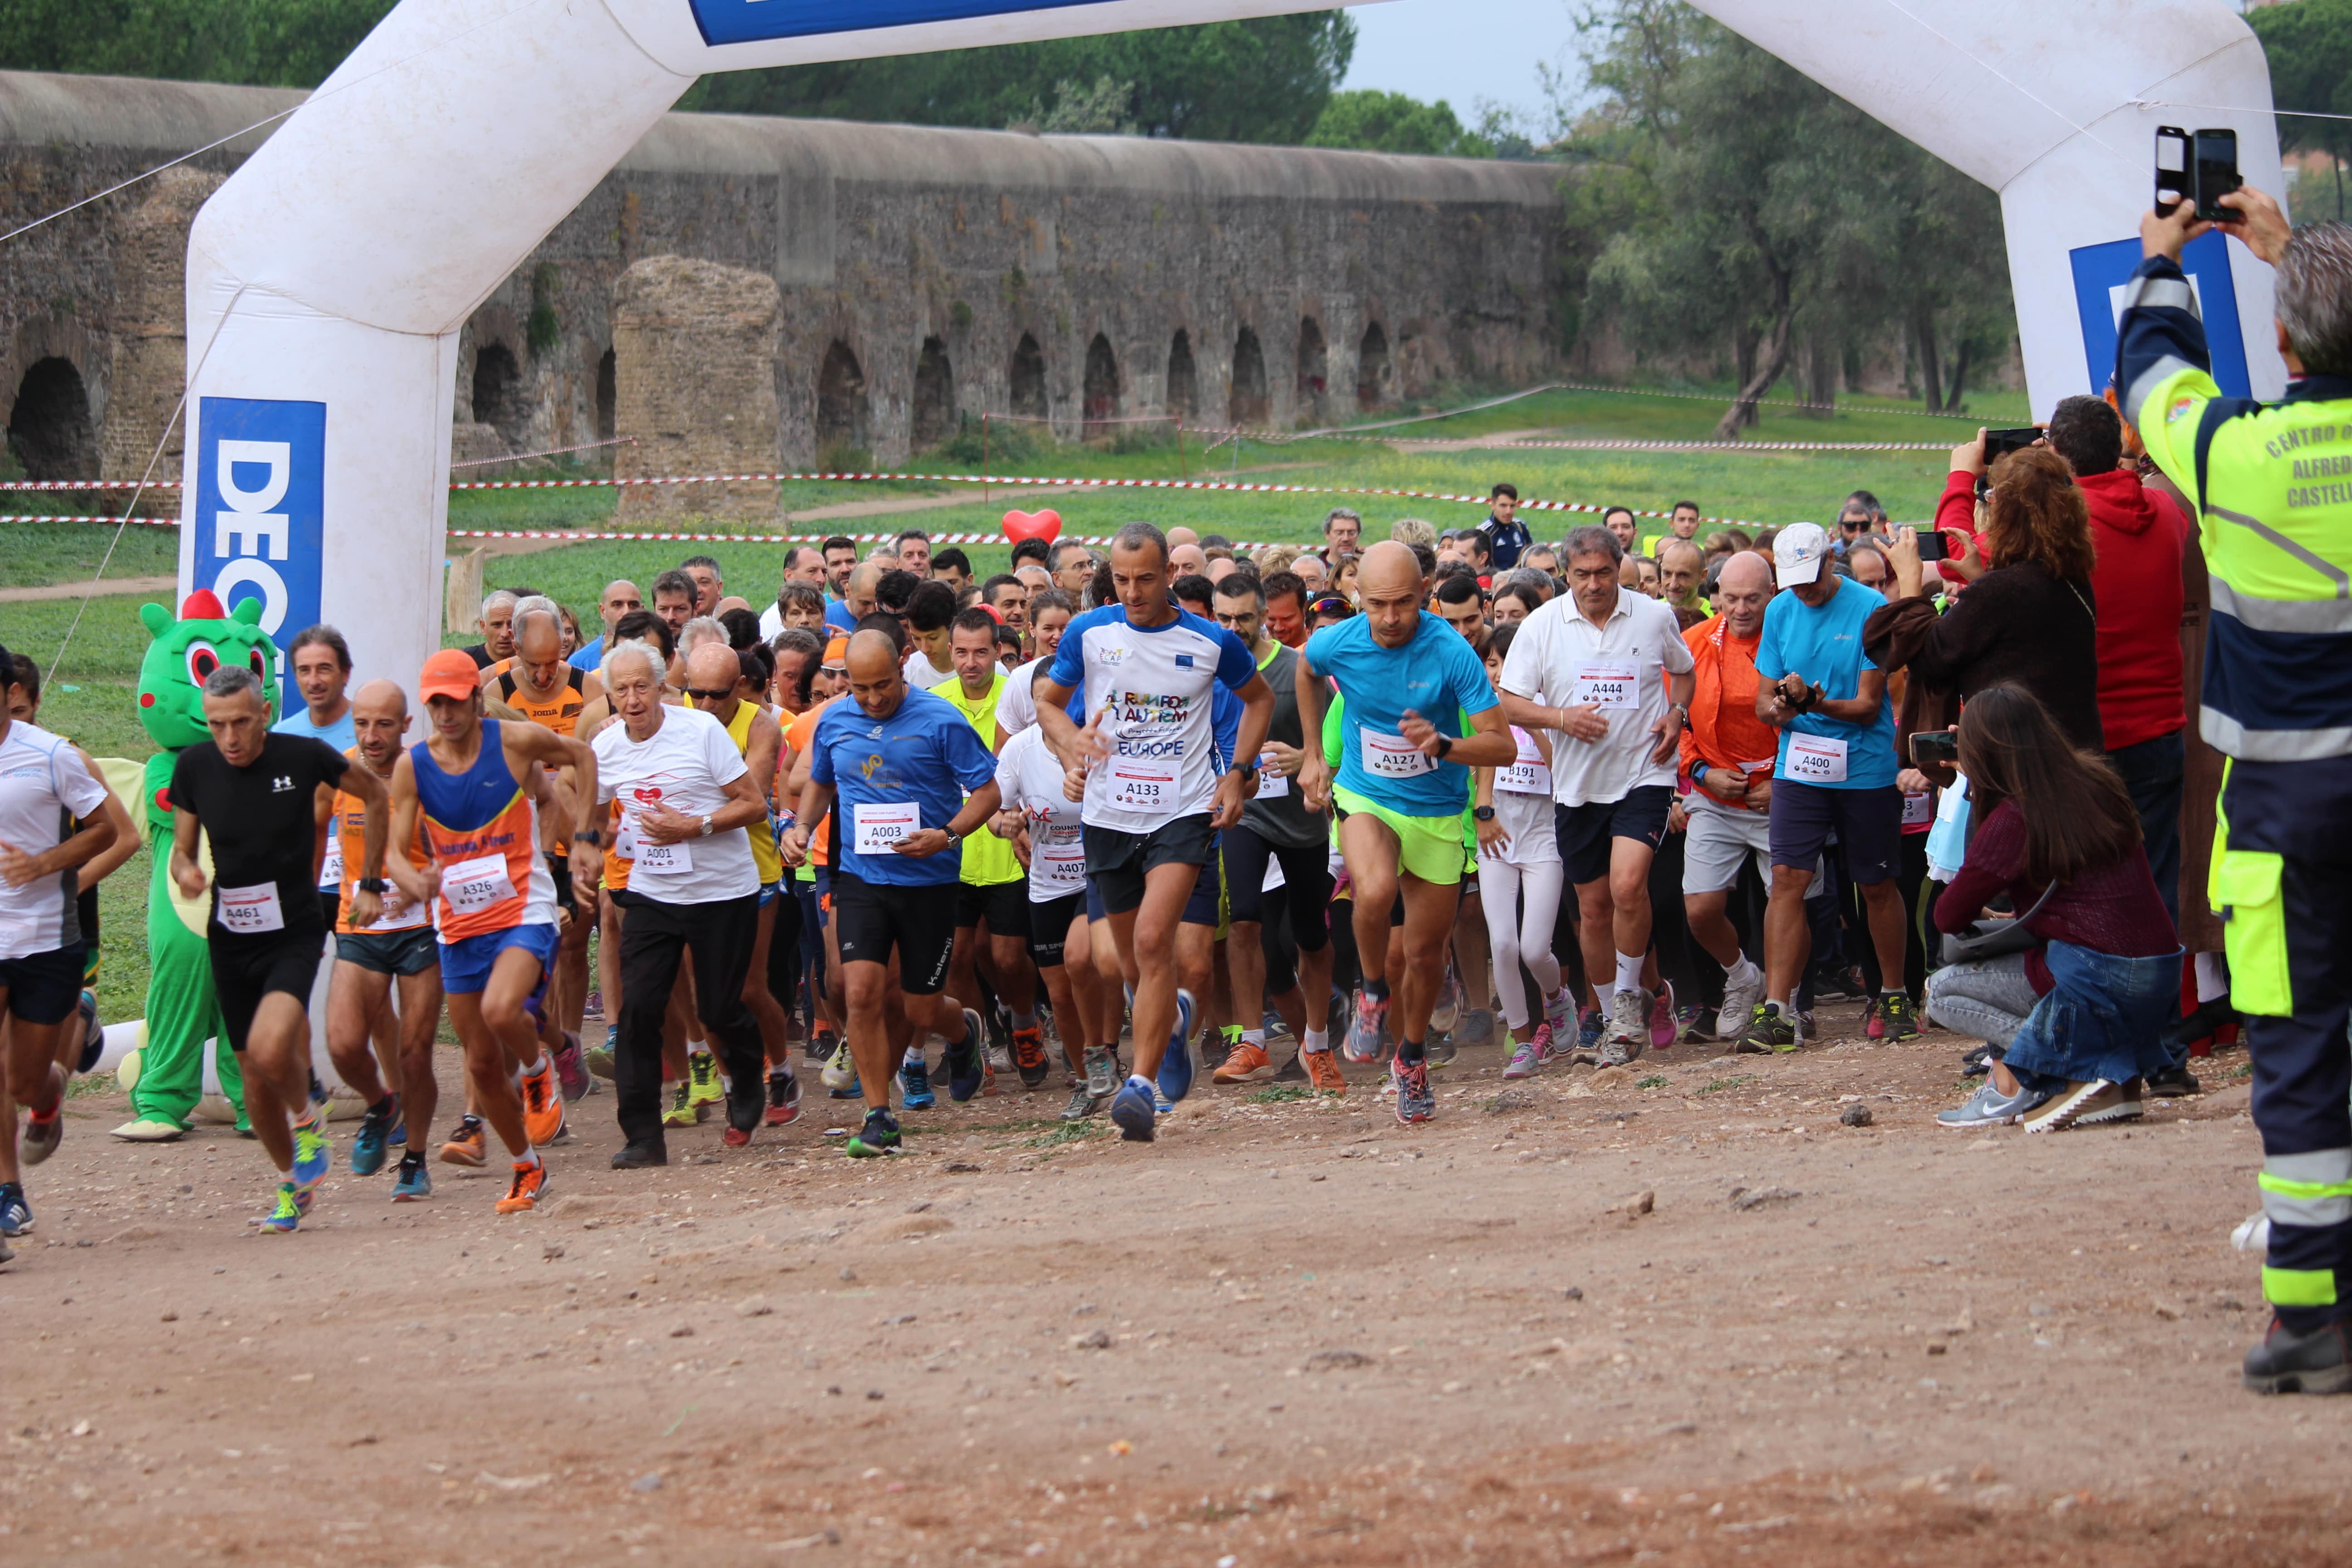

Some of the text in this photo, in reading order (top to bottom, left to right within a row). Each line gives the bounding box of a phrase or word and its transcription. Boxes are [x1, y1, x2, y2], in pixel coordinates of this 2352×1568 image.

[2266, 425, 2336, 460] CENTRO
[2293, 455, 2352, 480] ALFRED
[213, 439, 292, 637] DEC
[1100, 652, 1122, 662] ECAP
[1592, 684, 1622, 693] A444
[1125, 708, 1188, 723] AUTISM
[1118, 740, 1185, 755] EUROPE
[1383, 755, 1415, 764] A127
[1802, 756, 1829, 768] A400
[1509, 766, 1534, 777] B191
[1126, 783, 1159, 796] A133
[871, 827, 902, 837] A003
[647, 848, 672, 858] A001
[1058, 863, 1085, 872] A407
[463, 881, 492, 895] A326
[227, 908, 260, 918] A461
[927, 937, 952, 985] Kalenji
